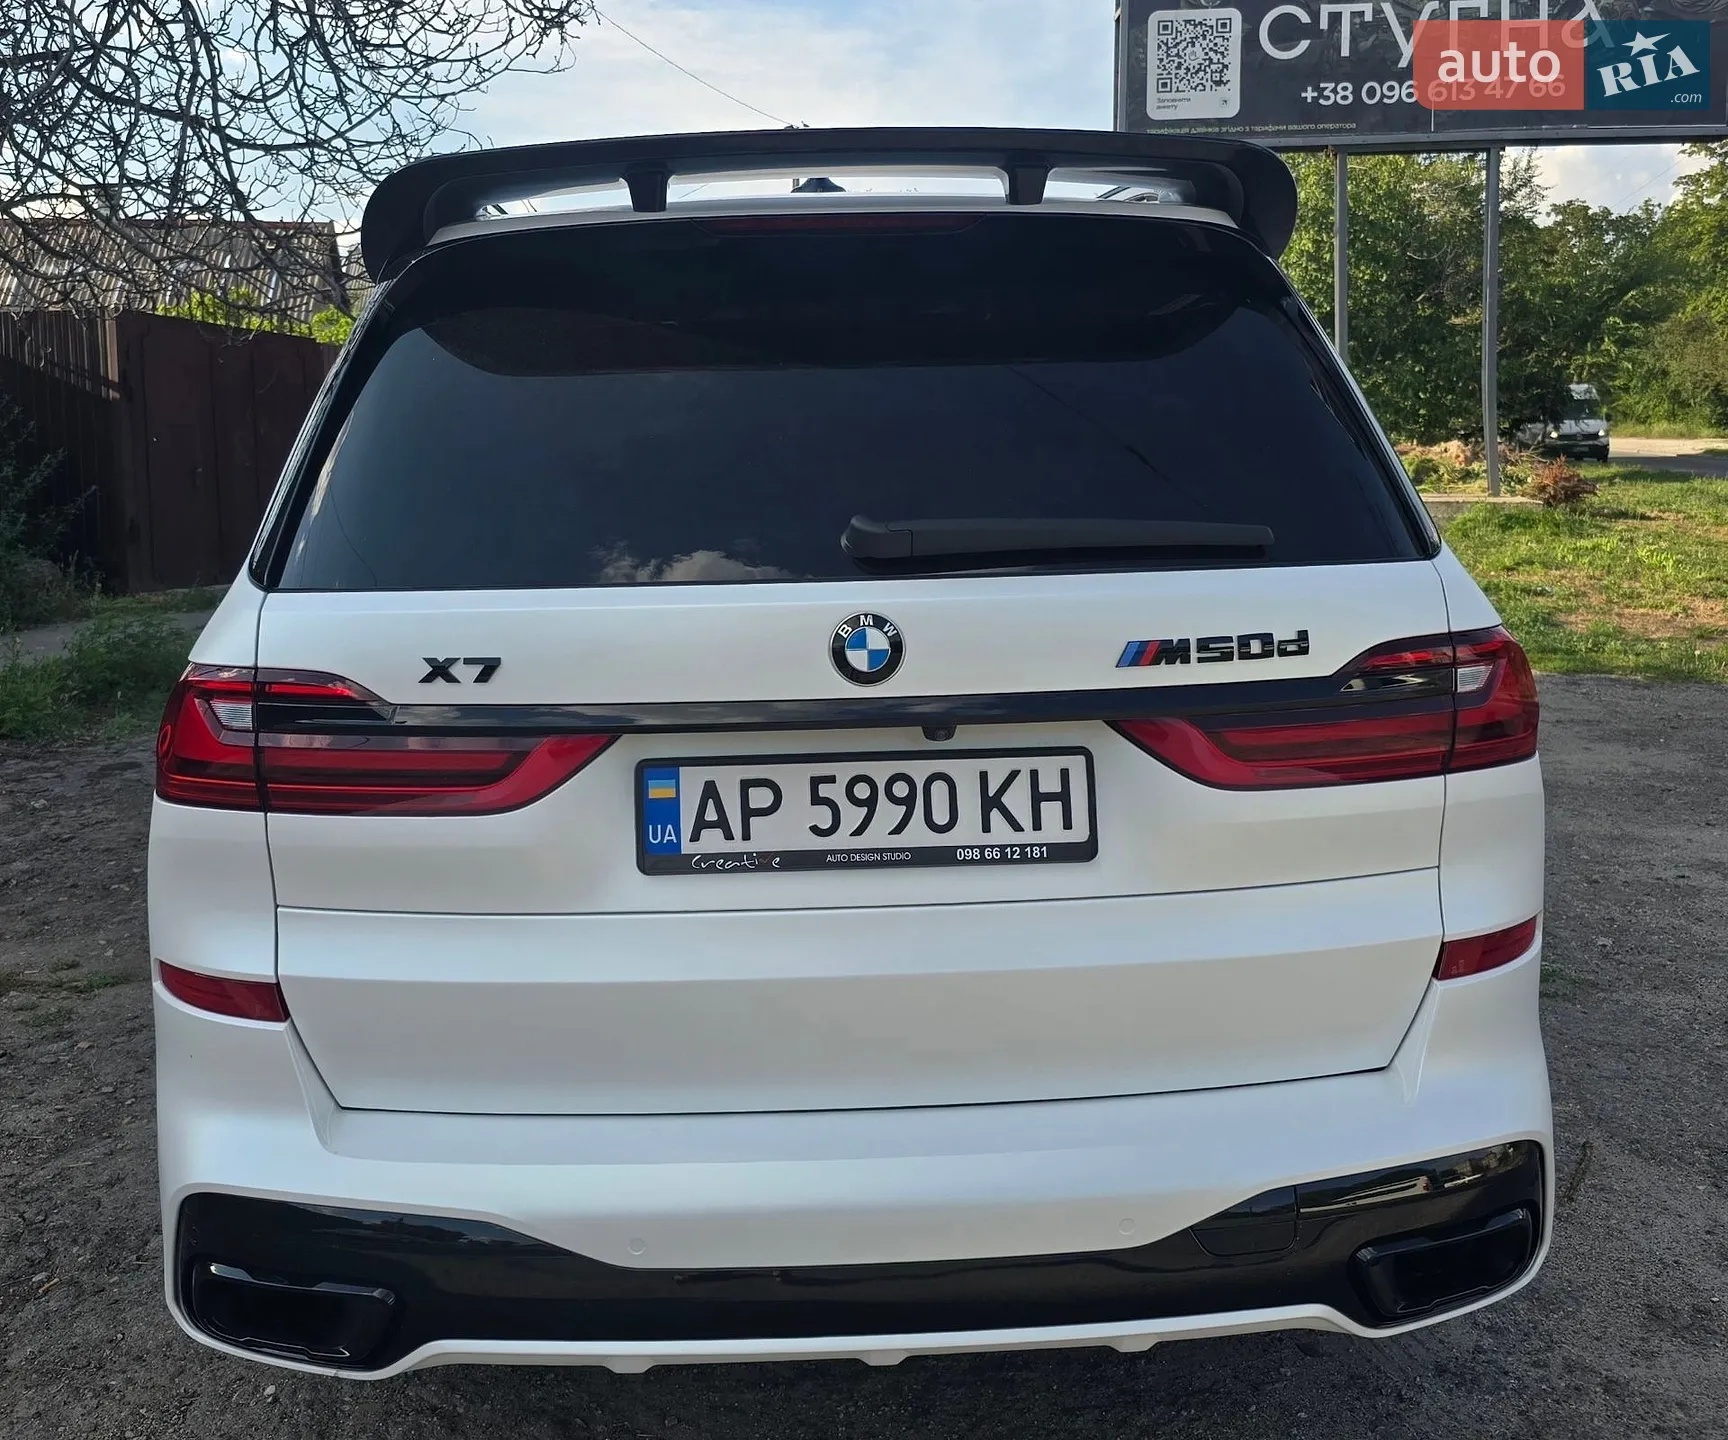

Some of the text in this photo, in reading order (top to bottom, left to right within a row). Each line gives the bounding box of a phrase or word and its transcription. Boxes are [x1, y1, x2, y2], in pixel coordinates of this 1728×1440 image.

[1301, 82, 1354, 105] +38
[1361, 80, 1419, 105] 096
[1427, 78, 1476, 102] 613
[838, 614, 897, 638] BMW
[418, 657, 502, 683] X7
[689, 767, 1073, 842] AP 5990 KH
[649, 824, 677, 844] UA
[826, 851, 912, 862] AUTO DESIGN STUDIO
[956, 846, 1048, 861] 098 66 12 181
